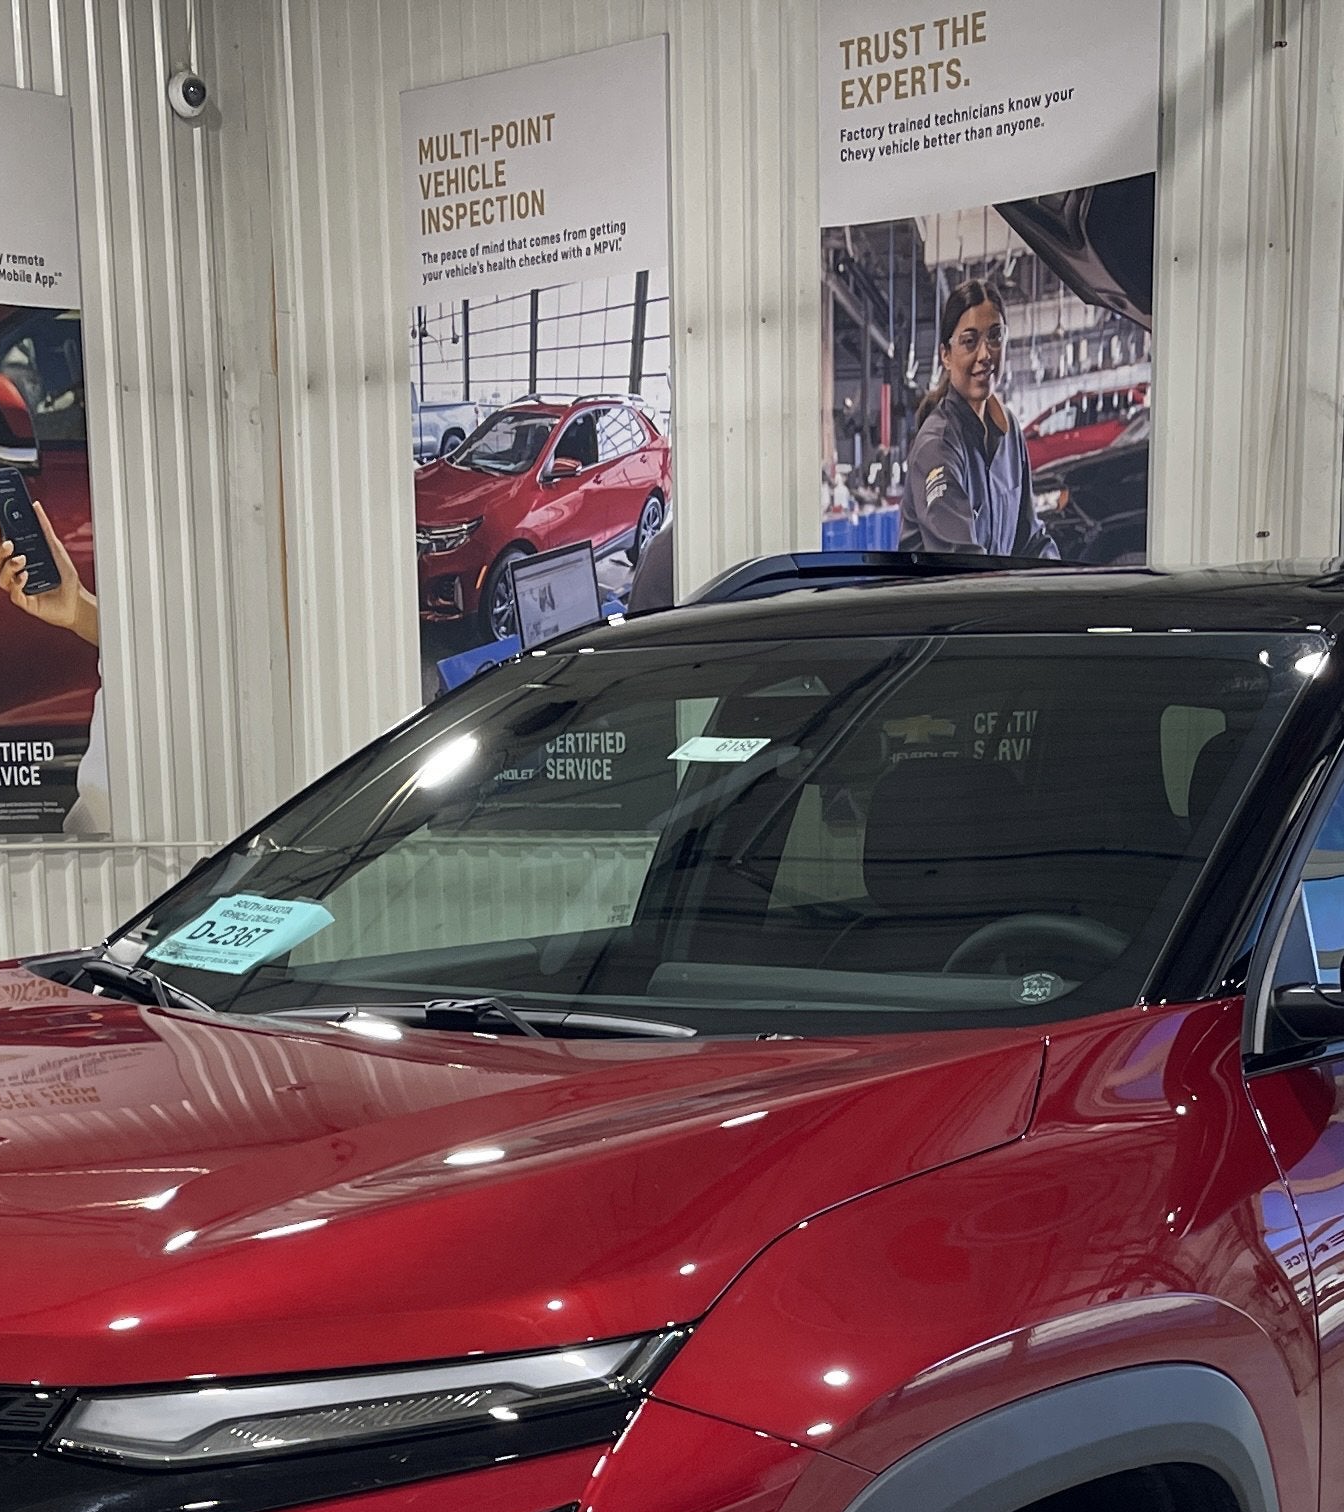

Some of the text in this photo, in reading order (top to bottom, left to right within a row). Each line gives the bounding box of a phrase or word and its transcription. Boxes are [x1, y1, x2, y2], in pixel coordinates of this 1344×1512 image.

[839, 10, 987, 70] TRUST THE
[841, 57, 971, 110] EXPERTS.
[840, 87, 1075, 143] Factory trained technicians know your
[418, 113, 556, 165] MULTI-POINT
[840, 115, 1045, 163] Chevy vehicle better than anyone.
[419, 159, 507, 200] VEHICLE
[421, 189, 545, 235] INSPECTION
[6, 252, 45, 267] remote
[422, 221, 626, 266] The peace of mind that comes from getting
[422, 269, 443, 286] your
[445, 262, 484, 278] vehicle's
[486, 256, 517, 272] health
[519, 250, 558, 268] checked
[560, 245, 583, 261] with
[585, 246, 592, 256] a
[546, 758, 613, 781] SERVICE
[186, 920, 274, 948] D-2367
